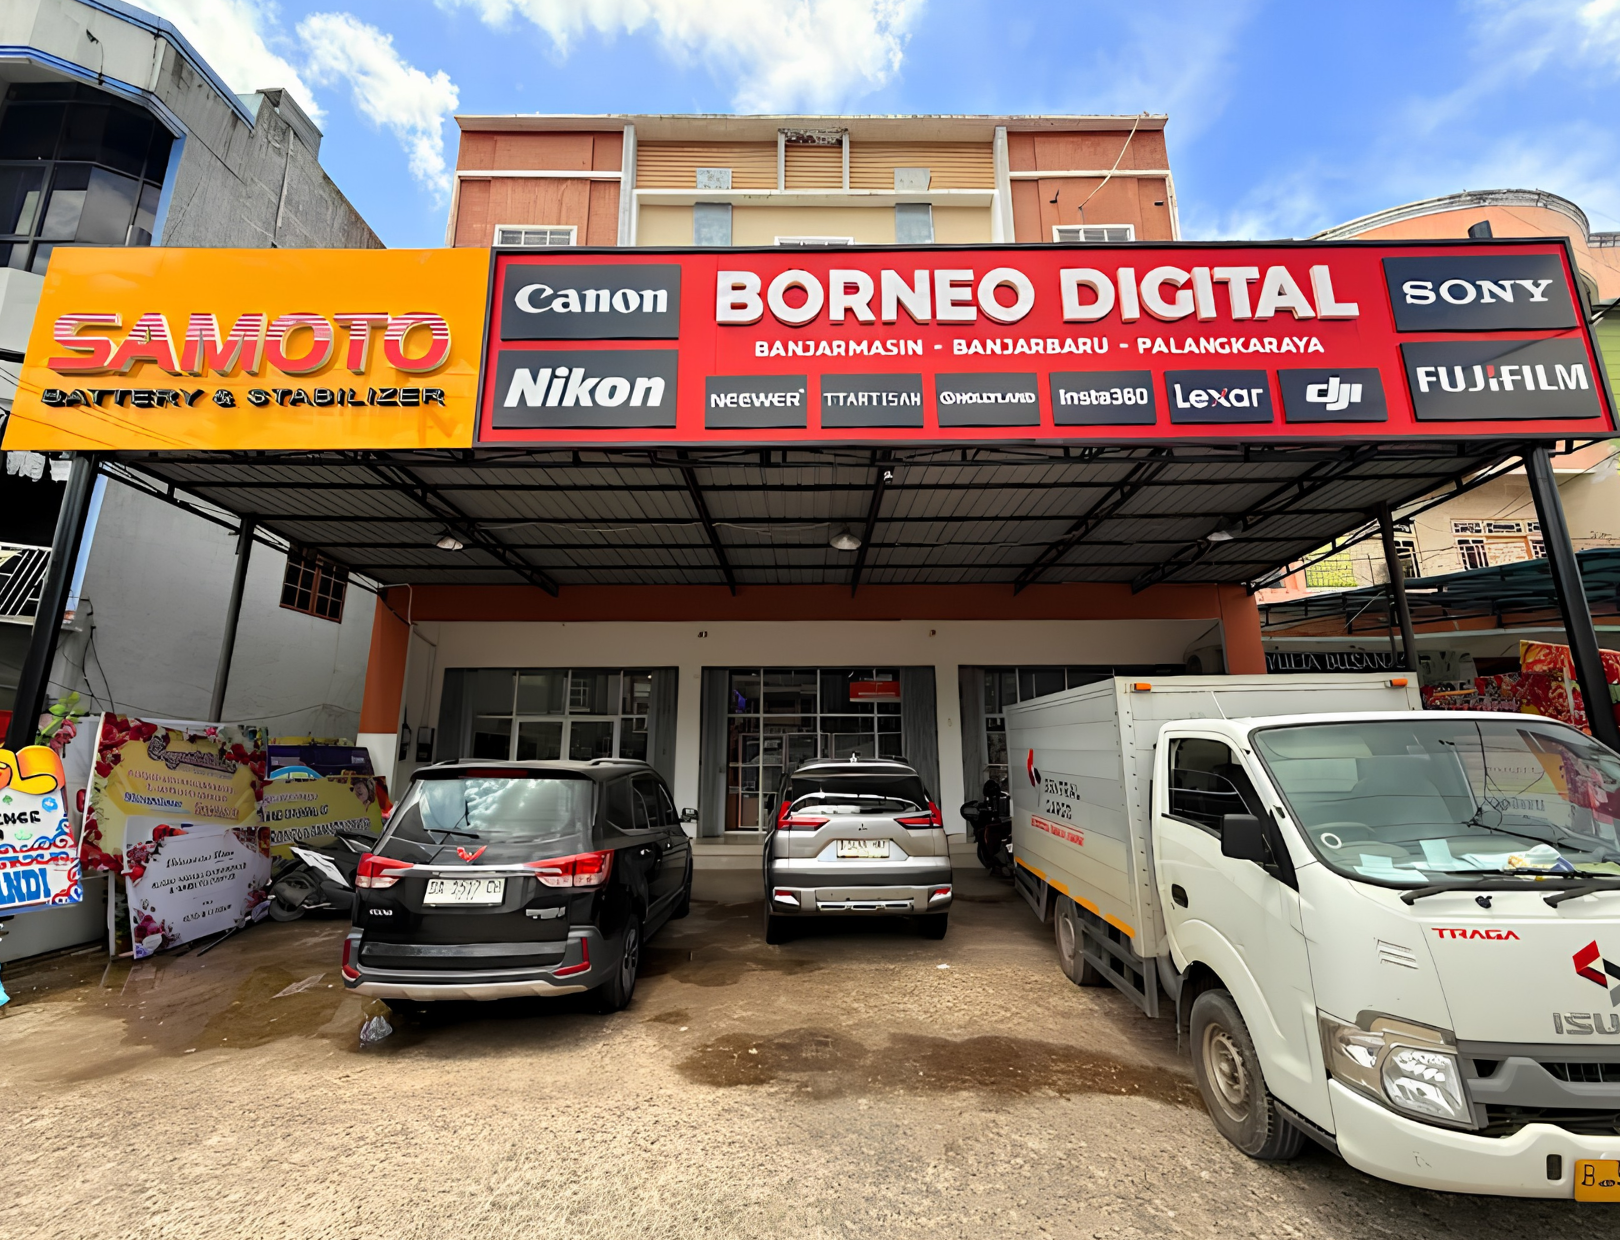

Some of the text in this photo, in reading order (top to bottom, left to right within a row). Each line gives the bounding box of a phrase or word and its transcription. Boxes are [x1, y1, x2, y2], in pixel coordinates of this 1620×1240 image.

[514, 283, 668, 314] Canon
[715, 264, 1360, 325] BORNEO DIGITAL
[1402, 278, 1554, 305] SONY
[47, 312, 453, 376] SAMOTO
[754, 339, 923, 357] BANJARMASIN
[953, 336, 1109, 355] BANJARBARU
[1137, 336, 1325, 354] PALANGKARAYA
[503, 366, 666, 408] Nikon
[1416, 363, 1589, 393] FUJIFILM
[41, 387, 446, 409] BATTERY & STABILIZER
[1058, 387, 1149, 406] Insta360
[1175, 383, 1264, 409] Lexar
[1431, 927, 1521, 941] TRAGA
